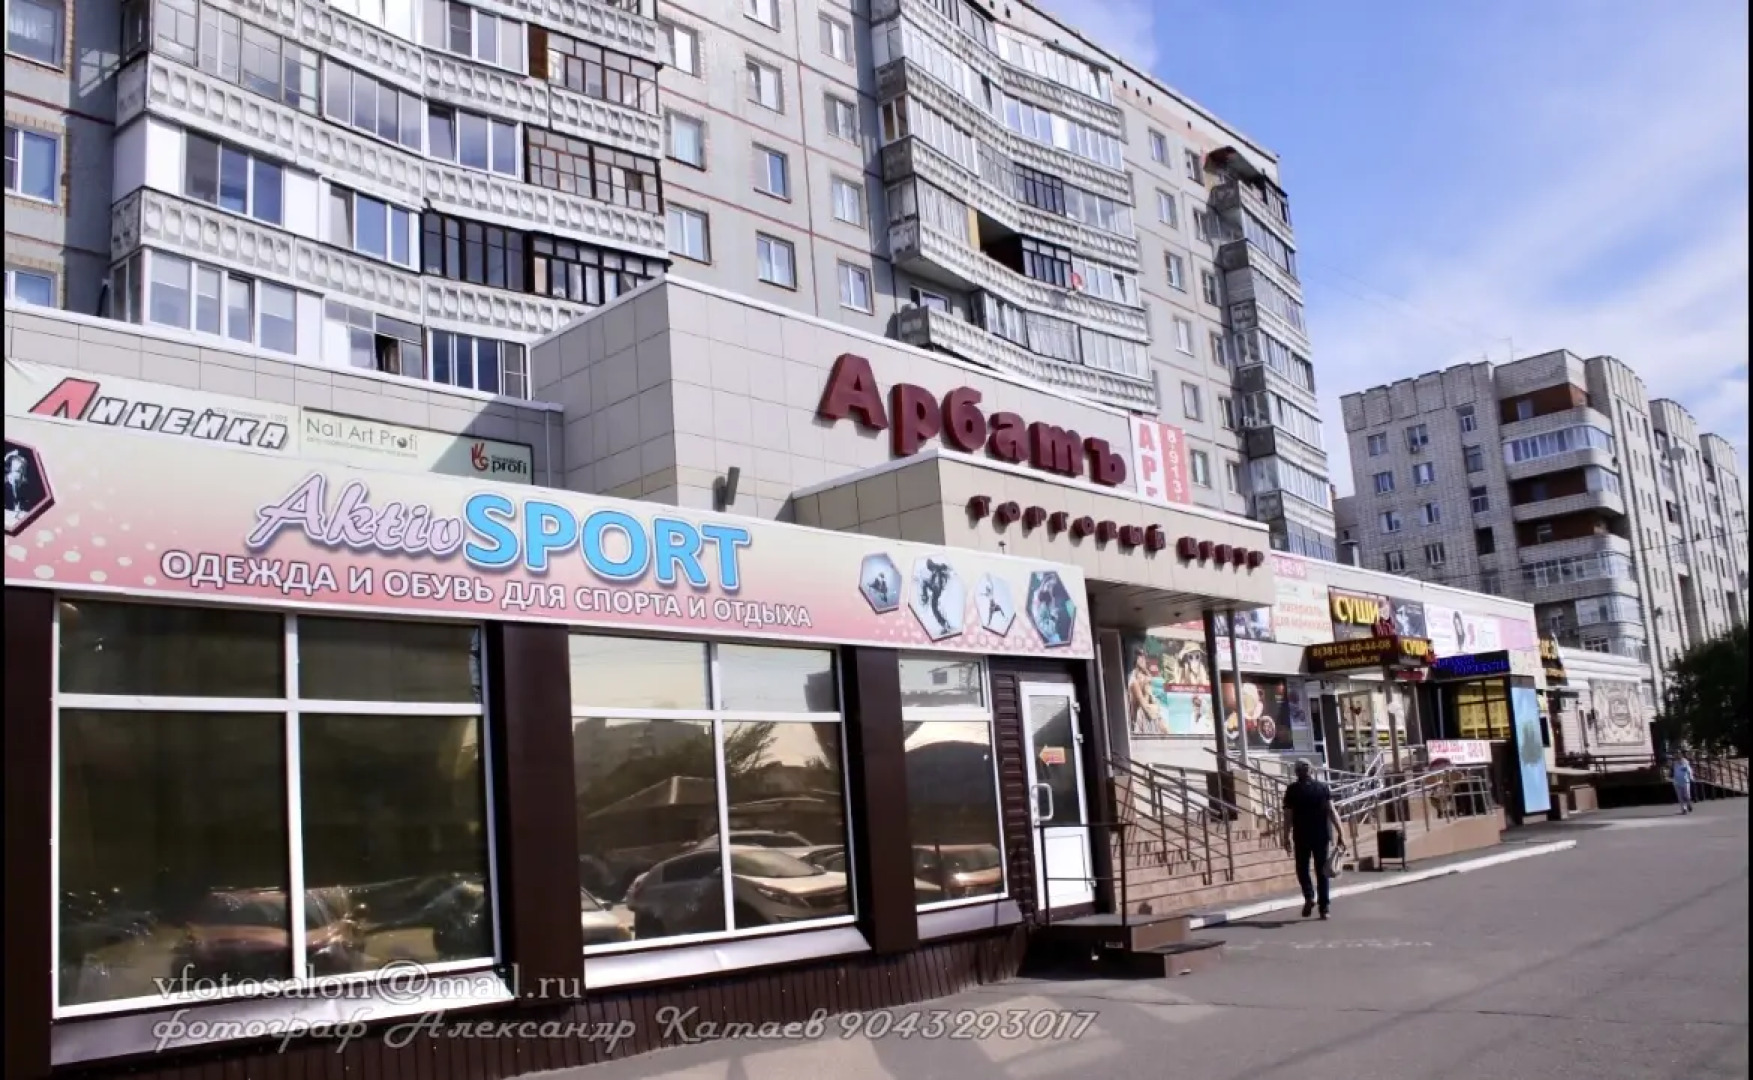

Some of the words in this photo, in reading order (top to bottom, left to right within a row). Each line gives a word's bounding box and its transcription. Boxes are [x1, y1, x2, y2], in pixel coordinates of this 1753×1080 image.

[306, 417, 343, 438] Nail
[349, 426, 374, 444] Art
[380, 429, 418, 451] Profi
[816, 352, 1127, 487] Арбатъ
[492, 459, 527, 475] profi
[160, 549, 339, 596] ОДЕЖДА
[348, 566, 374, 595] И
[383, 569, 494, 603] ОБУВЬ
[501, 579, 566, 611] ДЛЯ
[574, 586, 682, 618] СПОРТА
[688, 597, 706, 619] И
[713, 600, 812, 629] ОТДЫХА
[1336, 597, 1379, 624] СУШИ
